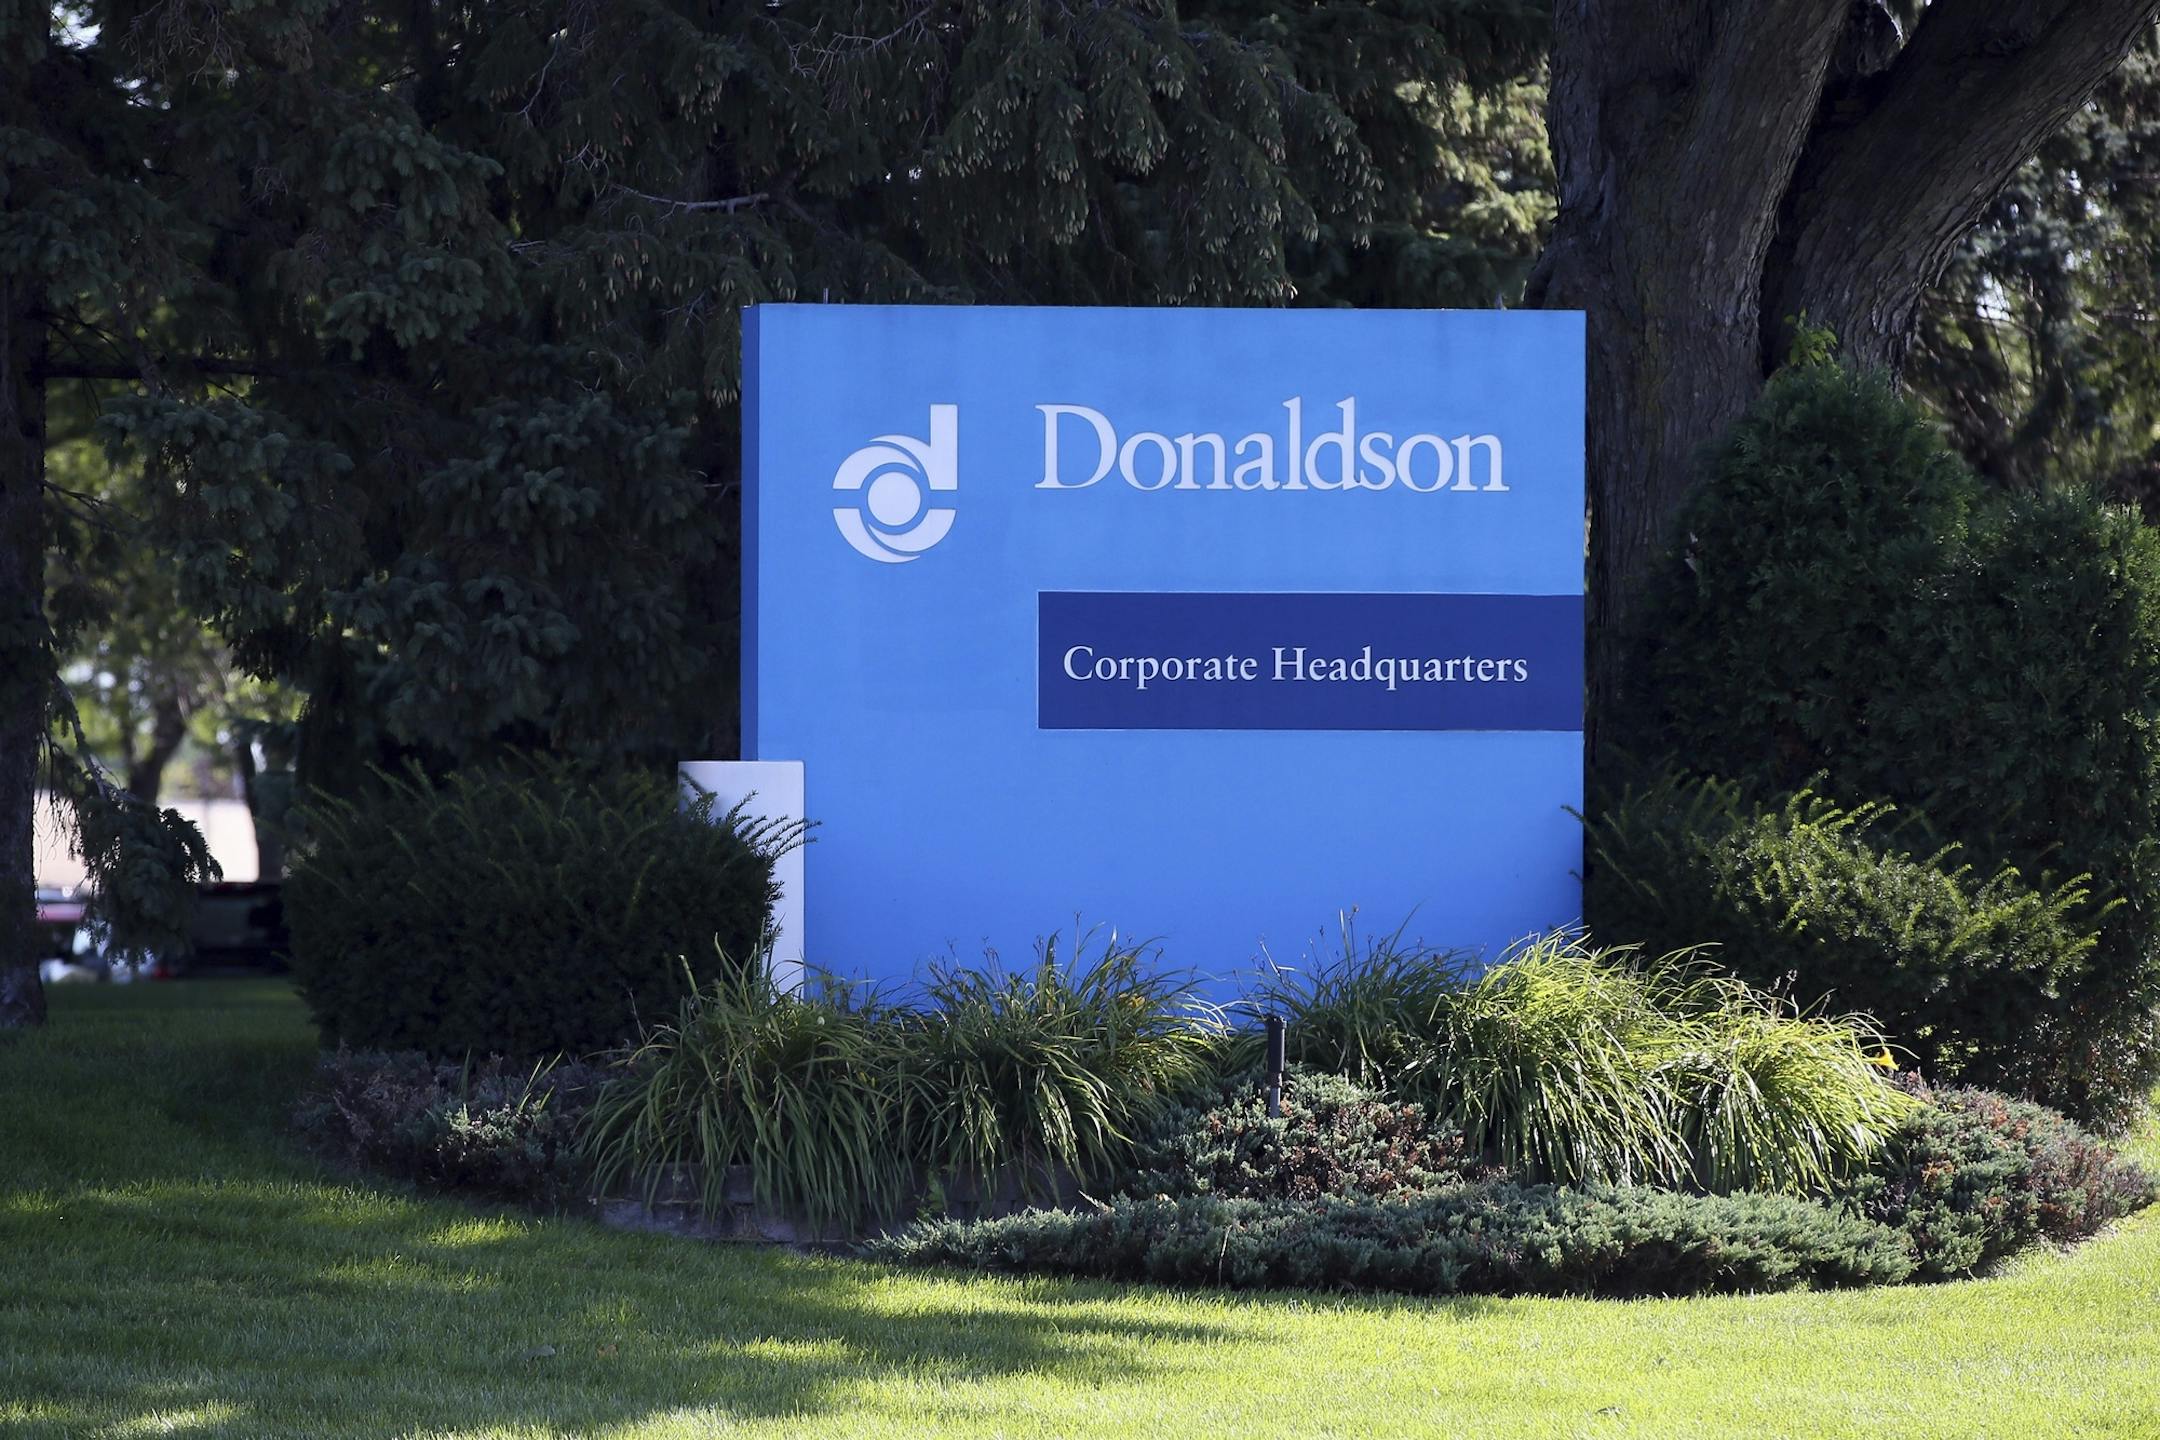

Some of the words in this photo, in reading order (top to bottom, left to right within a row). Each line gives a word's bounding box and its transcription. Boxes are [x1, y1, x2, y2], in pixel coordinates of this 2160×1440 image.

[1034, 396, 1511, 492] Donaldson
[1062, 644, 1259, 691] Corporate
[1271, 644, 1529, 691] Headquarters
